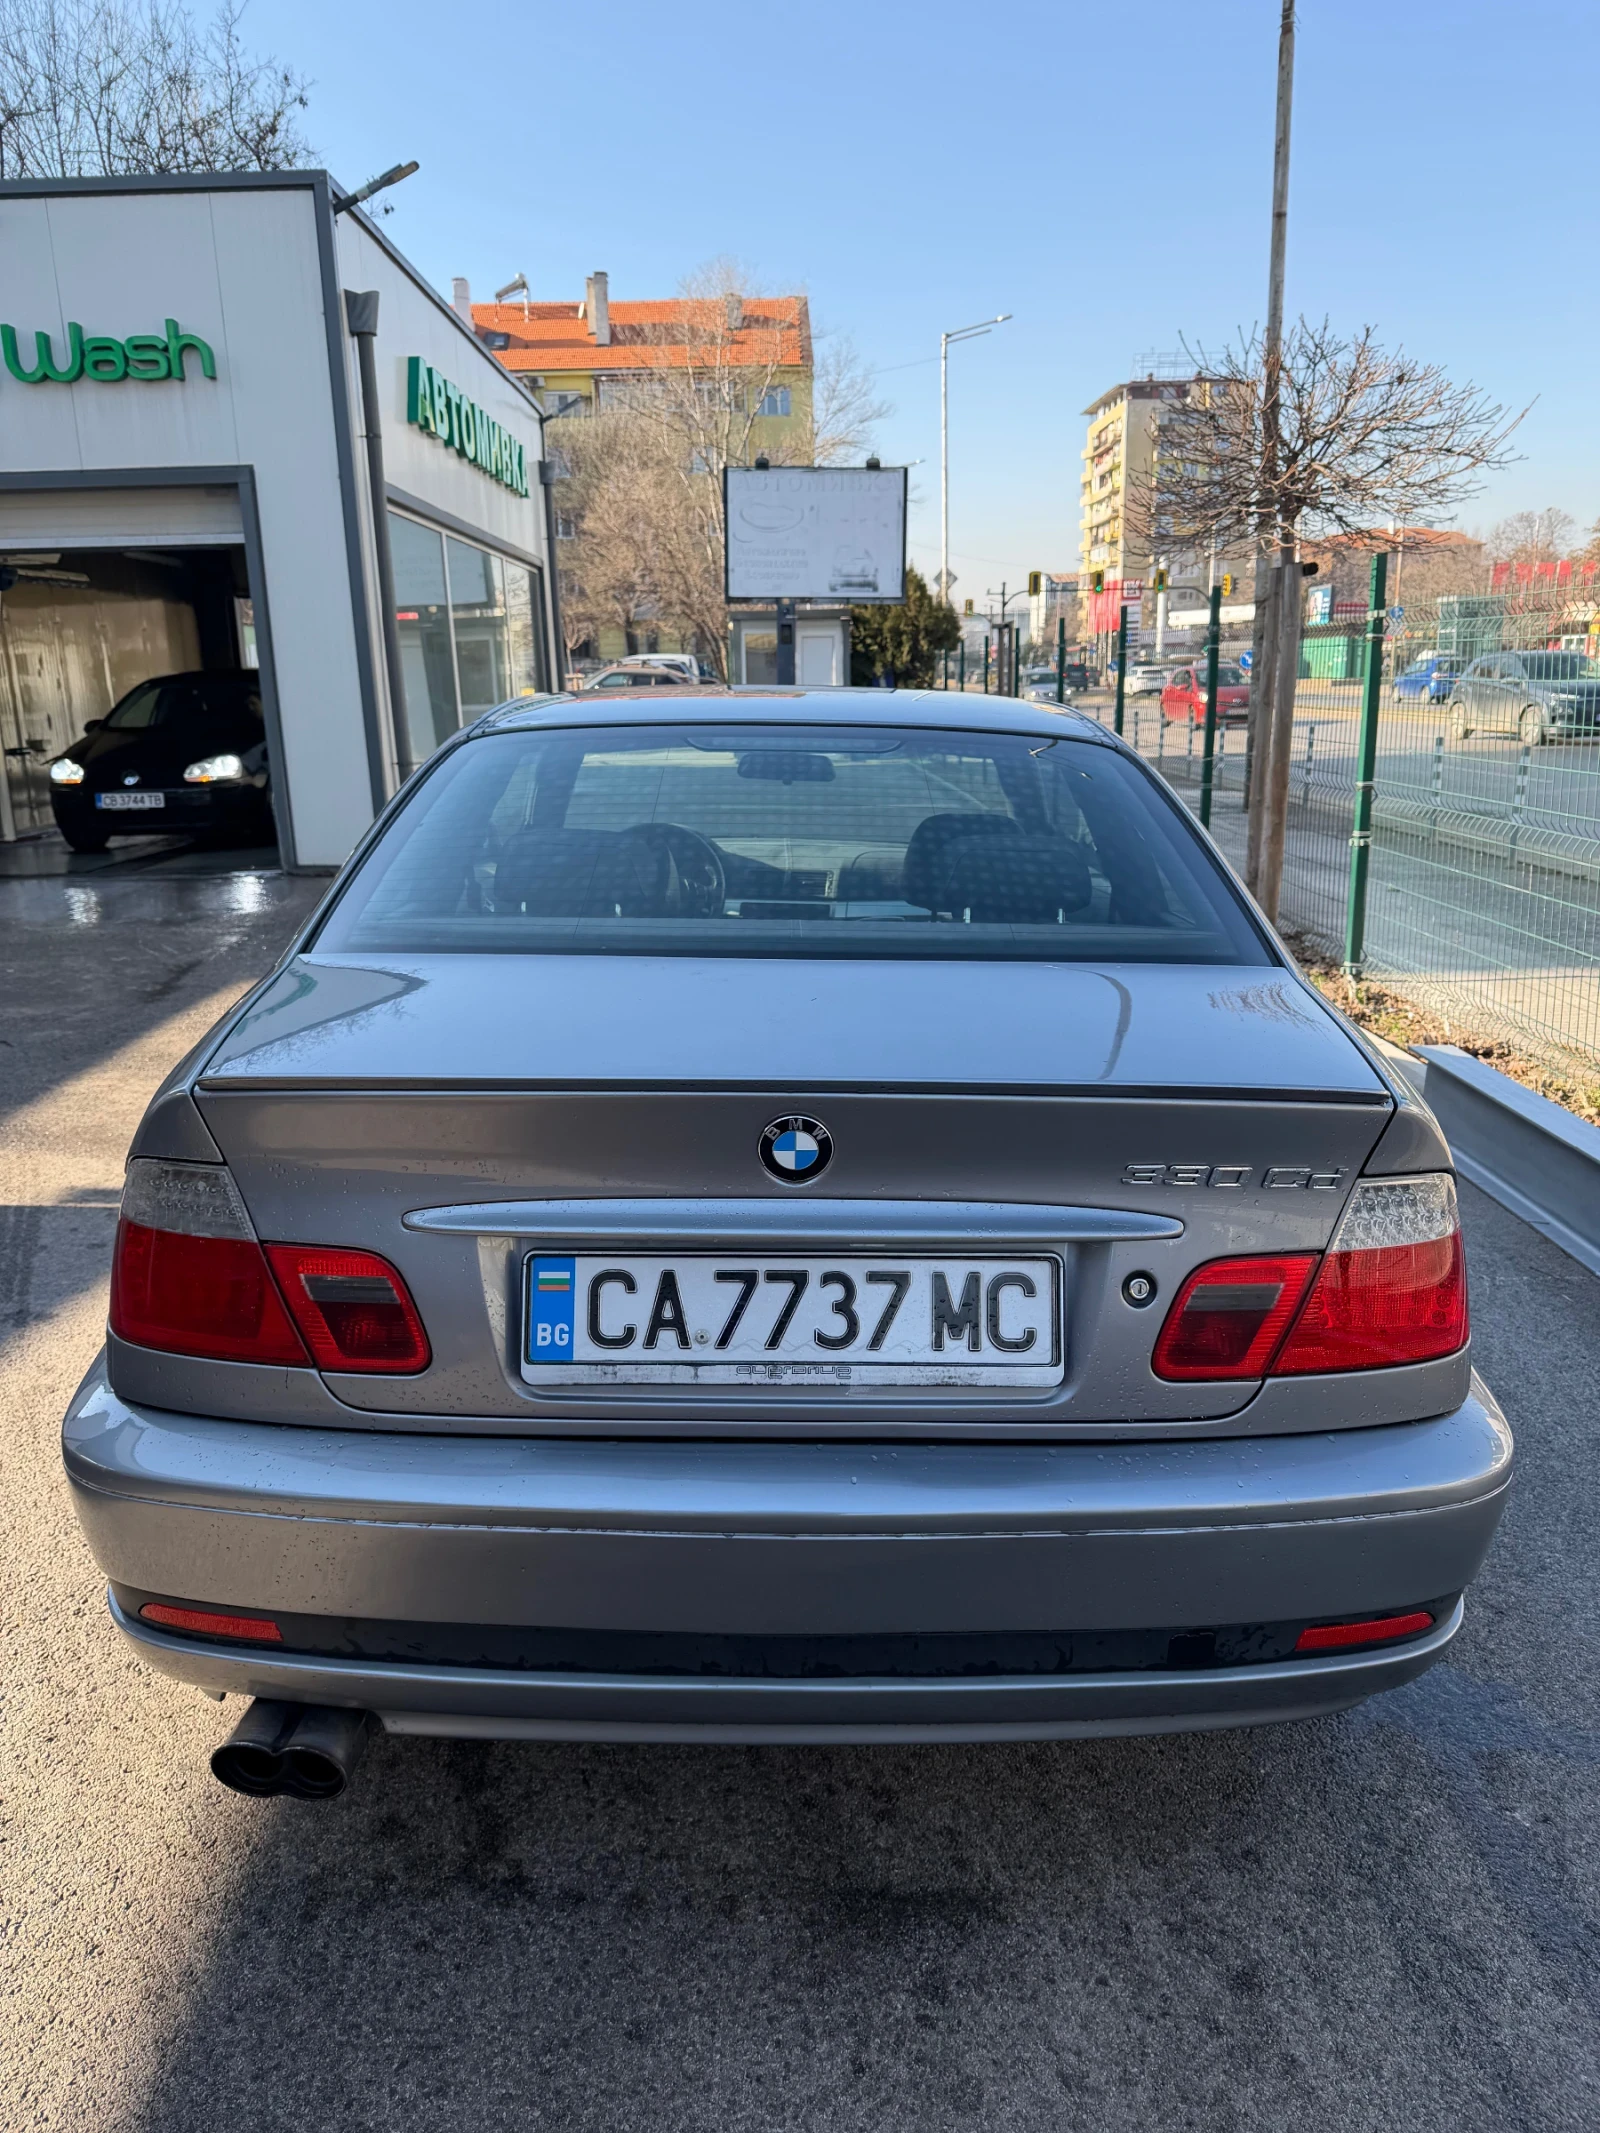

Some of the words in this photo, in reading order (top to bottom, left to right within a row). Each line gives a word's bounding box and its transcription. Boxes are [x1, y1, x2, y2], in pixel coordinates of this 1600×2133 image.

[0, 318, 217, 383] Wash
[408, 356, 530, 499] АВТОМИВКА
[765, 1118, 828, 1141] BMW
[1121, 1164, 1254, 1188] 330
[1260, 1165, 1350, 1190] Cd
[586, 1269, 693, 1350] CA
[713, 1270, 912, 1351] 7737
[931, 1271, 1038, 1353] MC
[536, 1322, 570, 1347] BG
